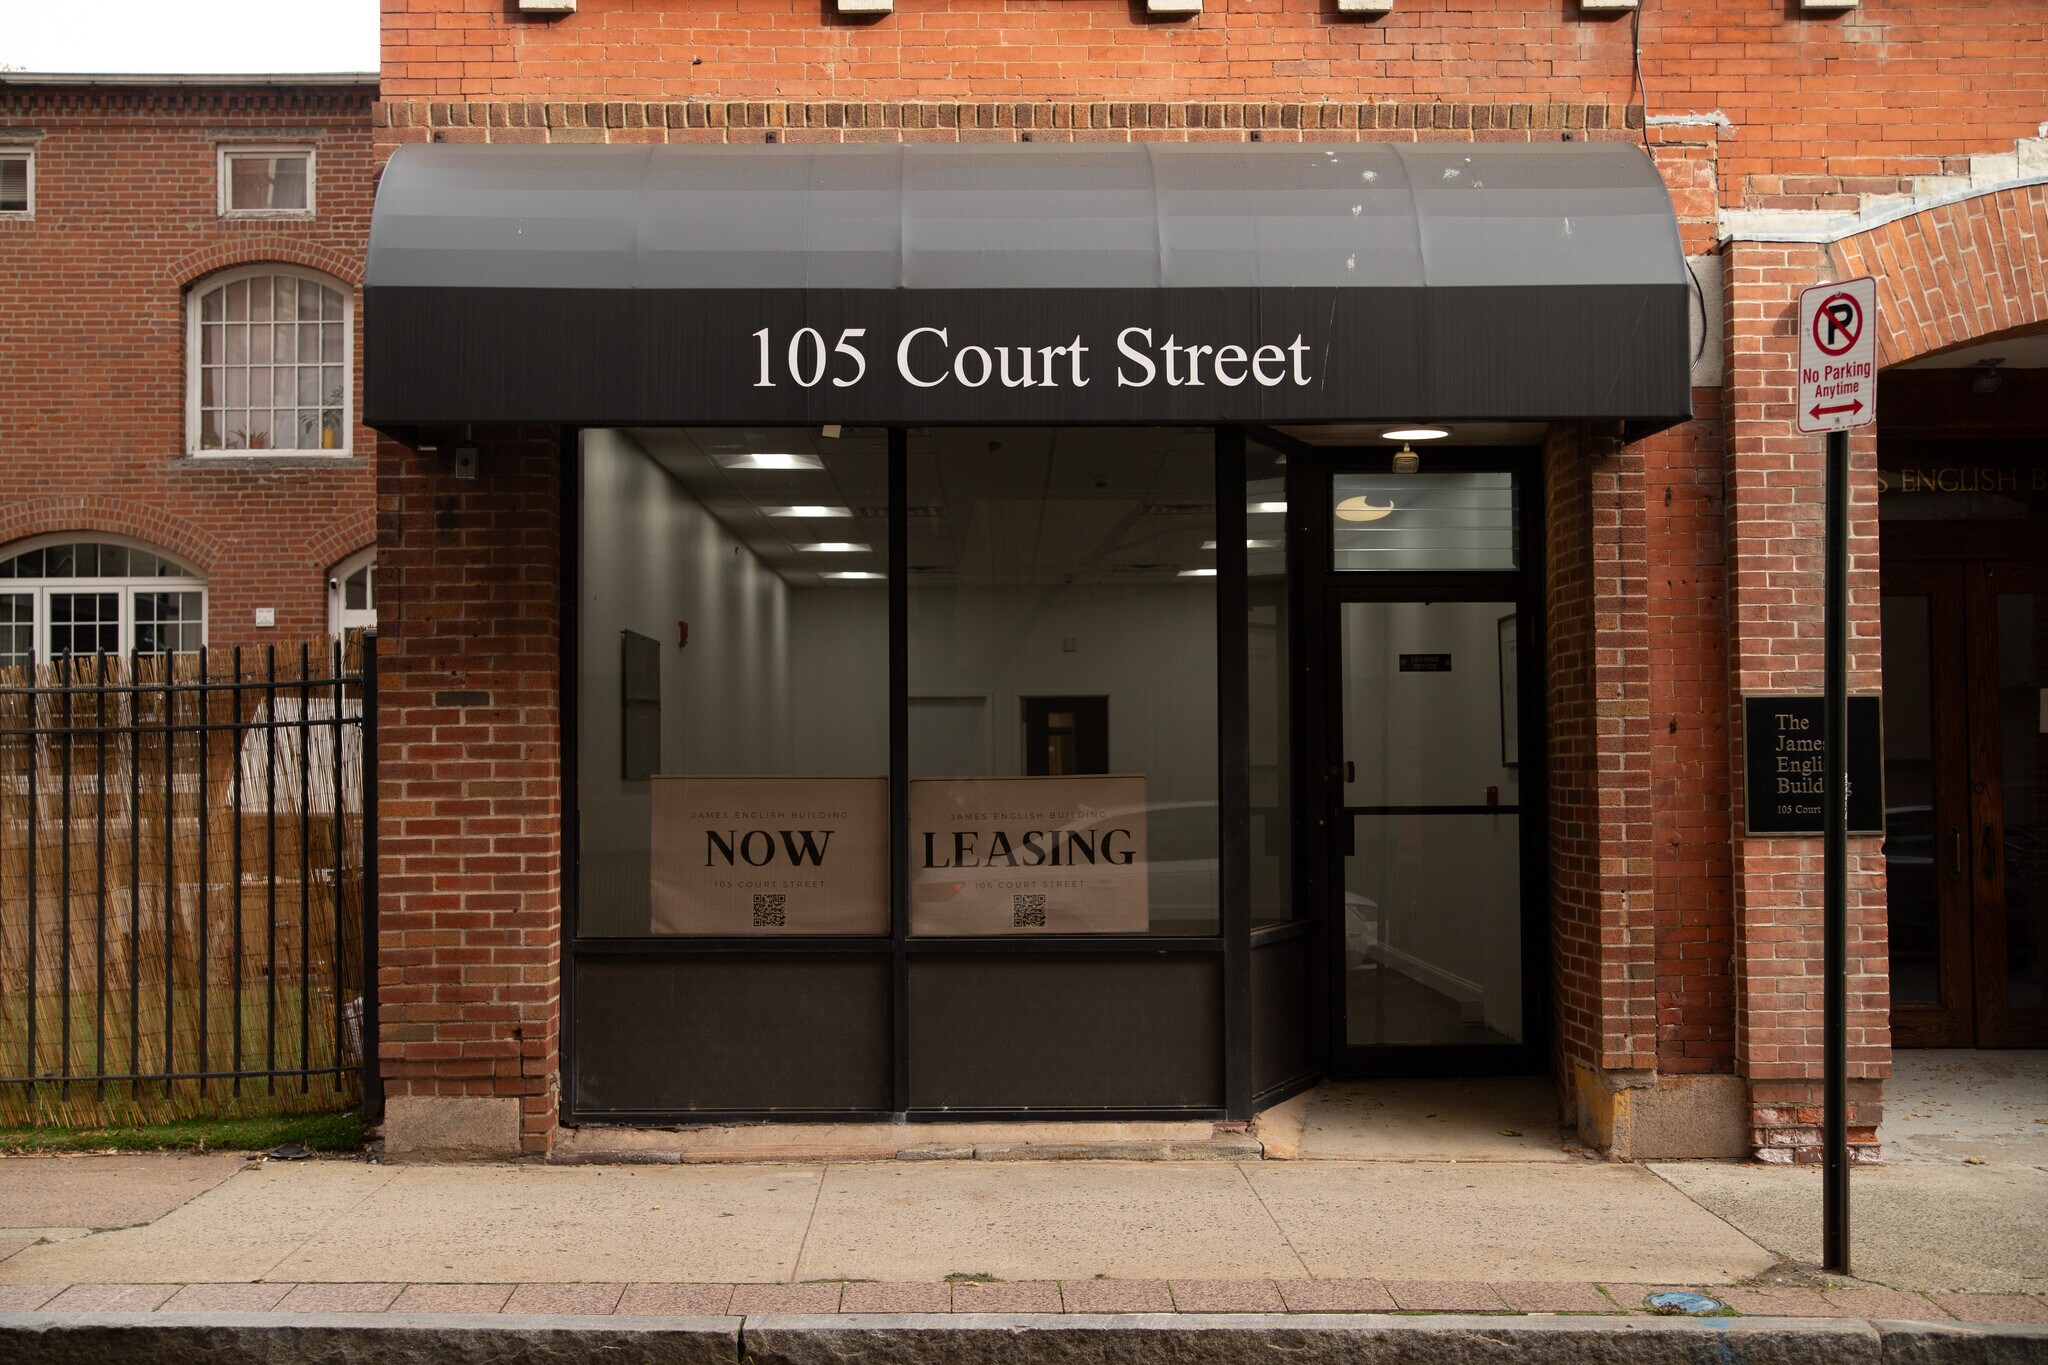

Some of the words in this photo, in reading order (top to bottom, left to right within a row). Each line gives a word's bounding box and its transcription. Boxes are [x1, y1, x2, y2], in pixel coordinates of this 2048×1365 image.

[752, 327, 866, 388] 105
[896, 327, 1090, 388] Court
[1116, 327, 1312, 388] Street
[1803, 368, 1819, 384] No
[1824, 362, 1871, 381] Parking
[1815, 381, 1859, 399] Anytime
[1901, 467, 2017, 492] ENGLISH
[1775, 714, 1810, 730] The
[1775, 735, 1824, 751] Jame
[1776, 756, 1824, 776] Engli
[691, 811, 728, 819] JAMES
[735, 811, 785, 819] ENGLISH
[791, 811, 848, 819] BUILDING
[993, 812, 1044, 820] ENGLISH
[1050, 811, 1107, 819] BUILDING
[1777, 805, 1792, 814] 105
[1795, 805, 1821, 814] Court
[704, 830, 835, 867] NOW
[921, 828, 1137, 868] LEASING
[975, 881, 993, 889] 105
[1043, 880, 1085, 888] STREET
